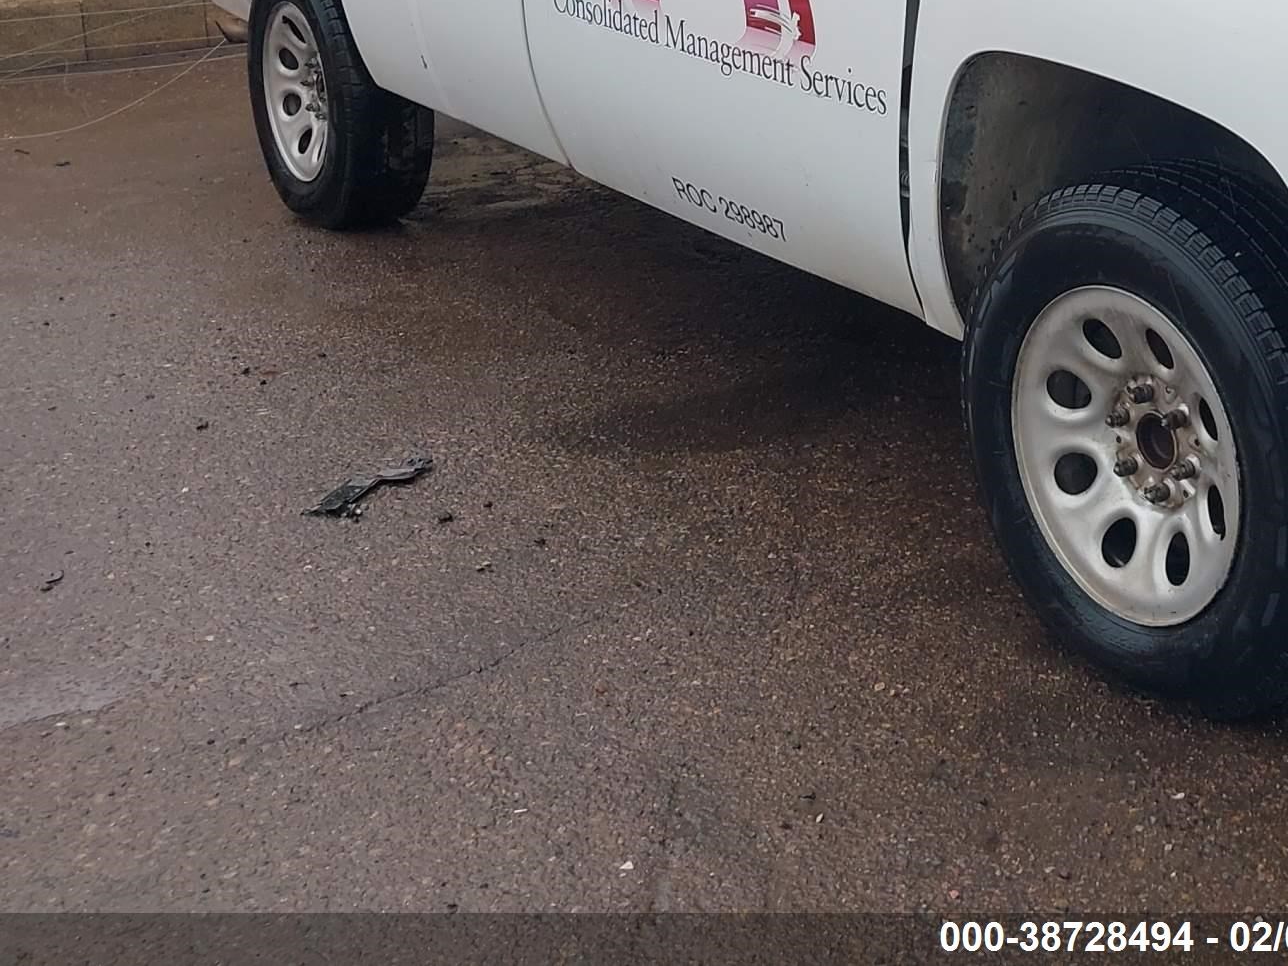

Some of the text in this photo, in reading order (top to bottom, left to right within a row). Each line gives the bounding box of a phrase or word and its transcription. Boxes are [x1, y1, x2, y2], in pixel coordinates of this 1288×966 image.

[664, 14, 795, 86] Management
[800, 54, 888, 116] Services
[672, 176, 787, 242] ROC 298987
